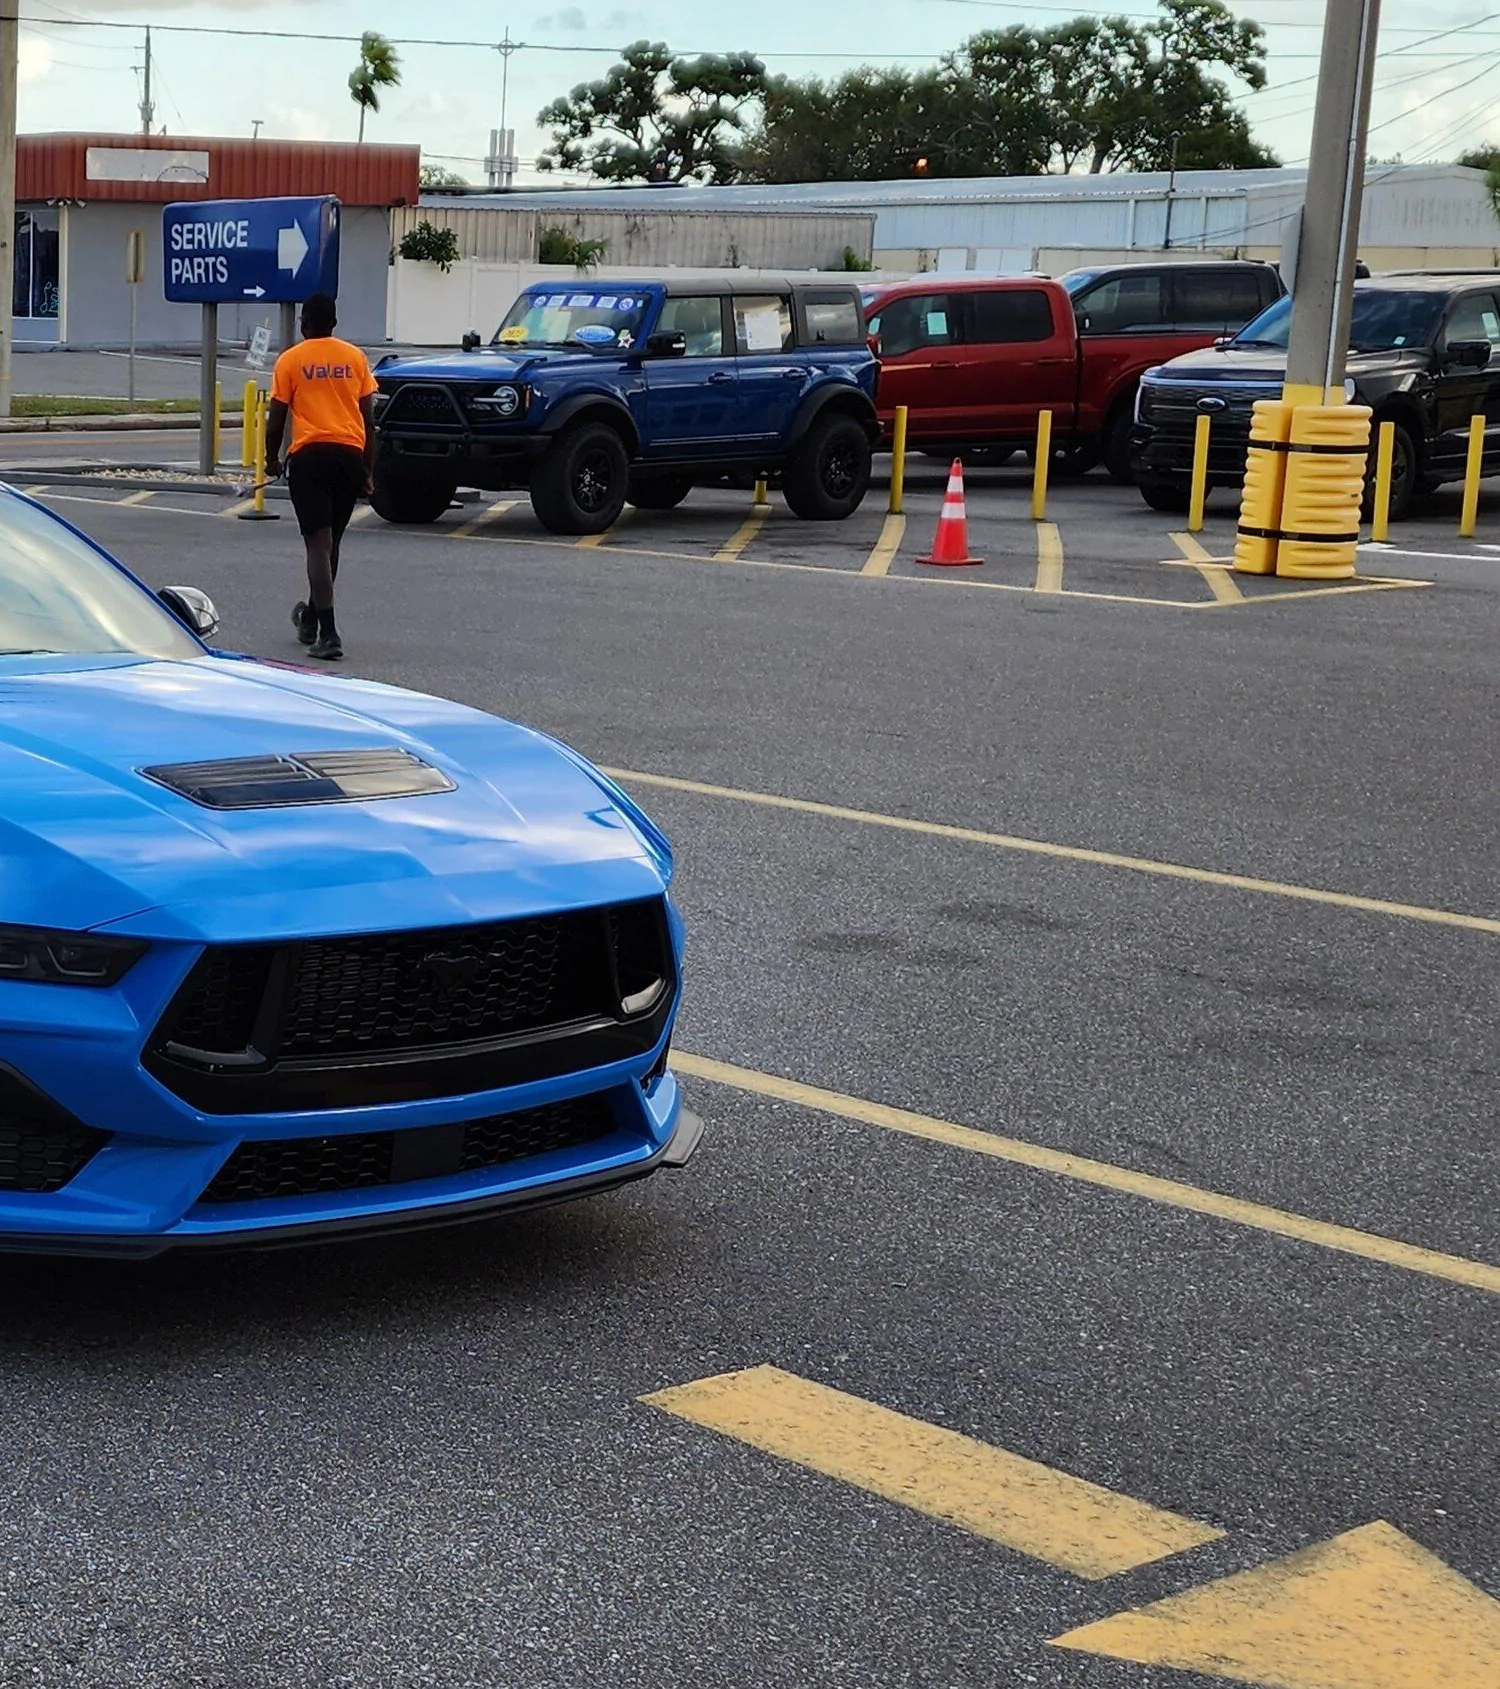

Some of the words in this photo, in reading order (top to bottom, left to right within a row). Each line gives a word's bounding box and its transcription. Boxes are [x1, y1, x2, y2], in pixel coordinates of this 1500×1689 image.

[171, 220, 249, 251] SERVICE
[171, 256, 229, 285] PARTS
[303, 363, 352, 380] Valet
